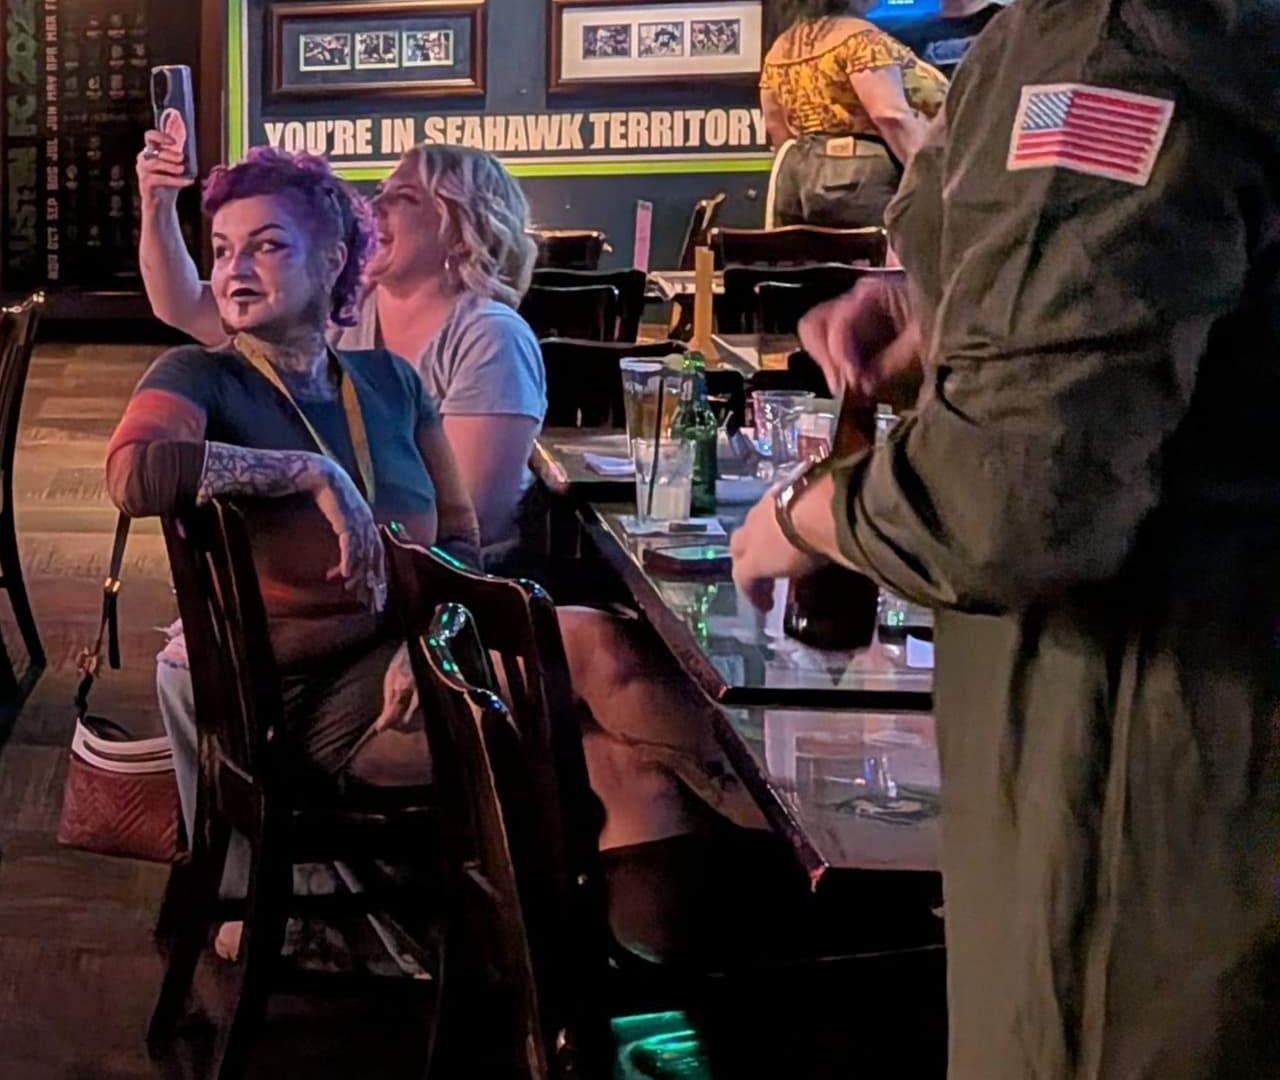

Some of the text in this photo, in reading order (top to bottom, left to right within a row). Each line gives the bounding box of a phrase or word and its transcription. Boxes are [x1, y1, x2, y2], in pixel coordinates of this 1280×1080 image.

[264, 108, 769, 155] YOU'RE IN SEAHAWK TERRITORY
